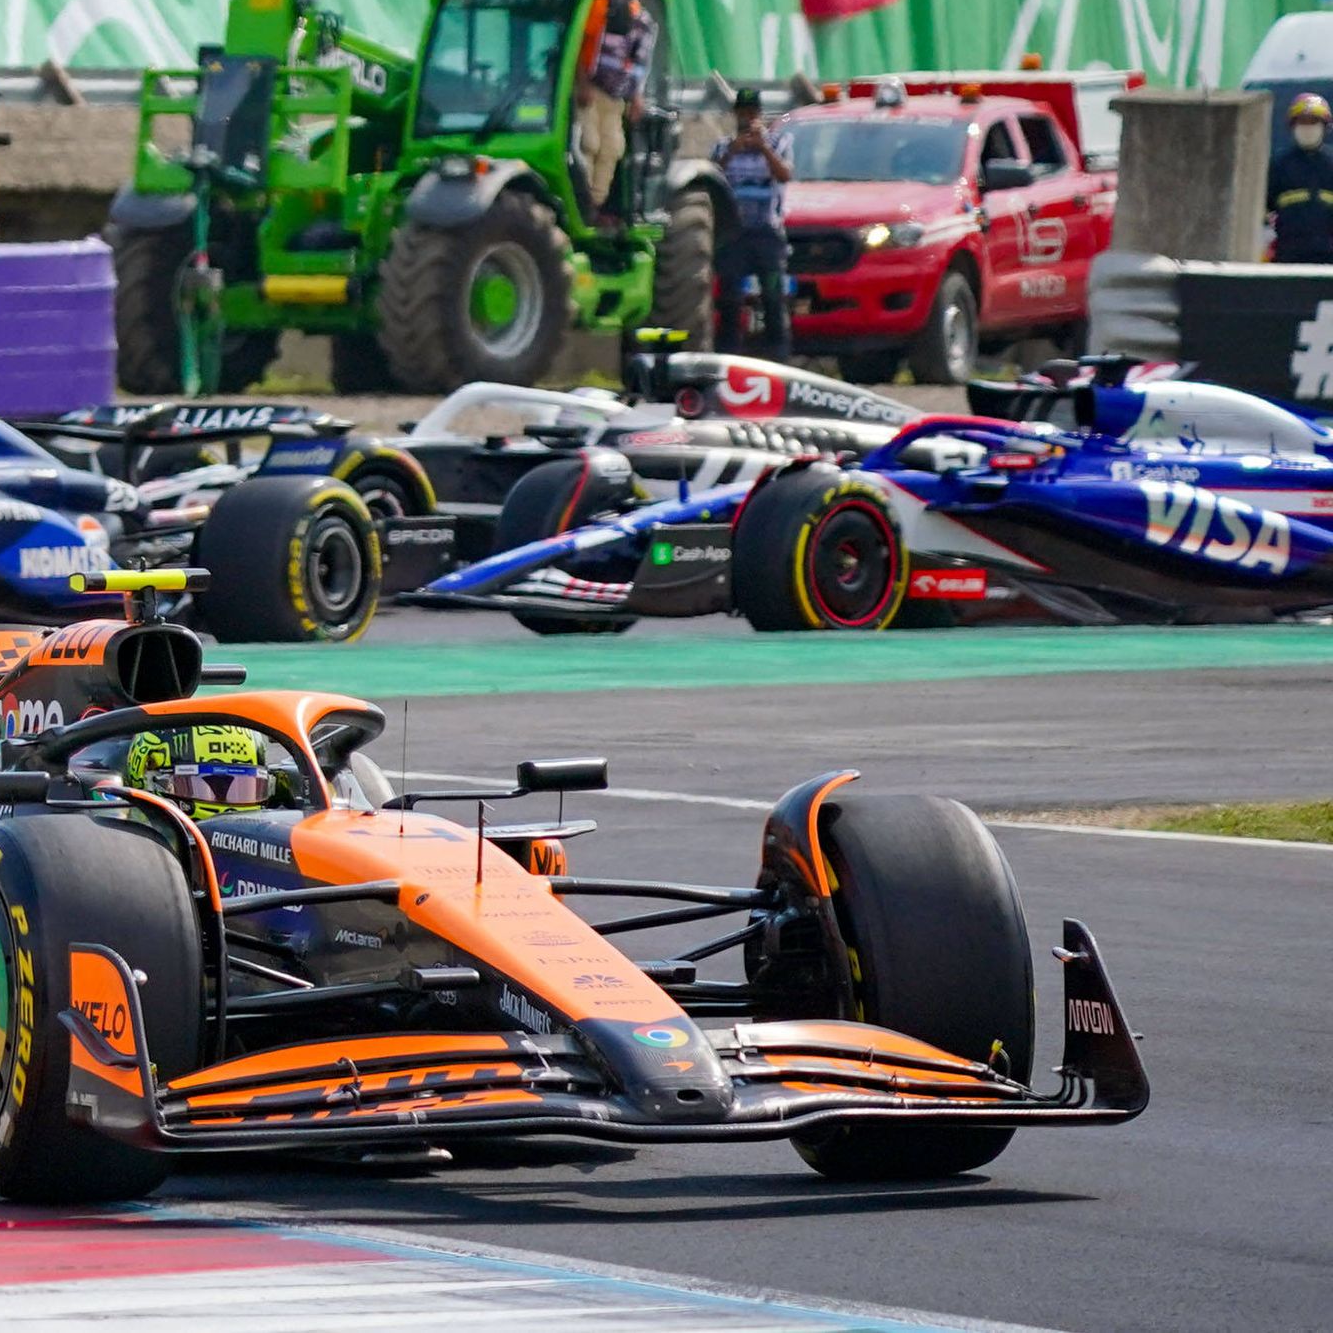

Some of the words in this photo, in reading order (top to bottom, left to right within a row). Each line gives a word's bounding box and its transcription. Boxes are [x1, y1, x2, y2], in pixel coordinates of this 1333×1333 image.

[1139, 479, 1290, 575] VISA
[673, 544, 704, 562] Cash
[706, 545, 732, 563] App
[209, 741, 247, 755] OKX
[211, 831, 257, 856] RICHARD
[259, 843, 291, 864] MILLE
[11, 905, 30, 936] P
[335, 928, 382, 949] McLaren
[11, 947, 34, 1108] ZERO
